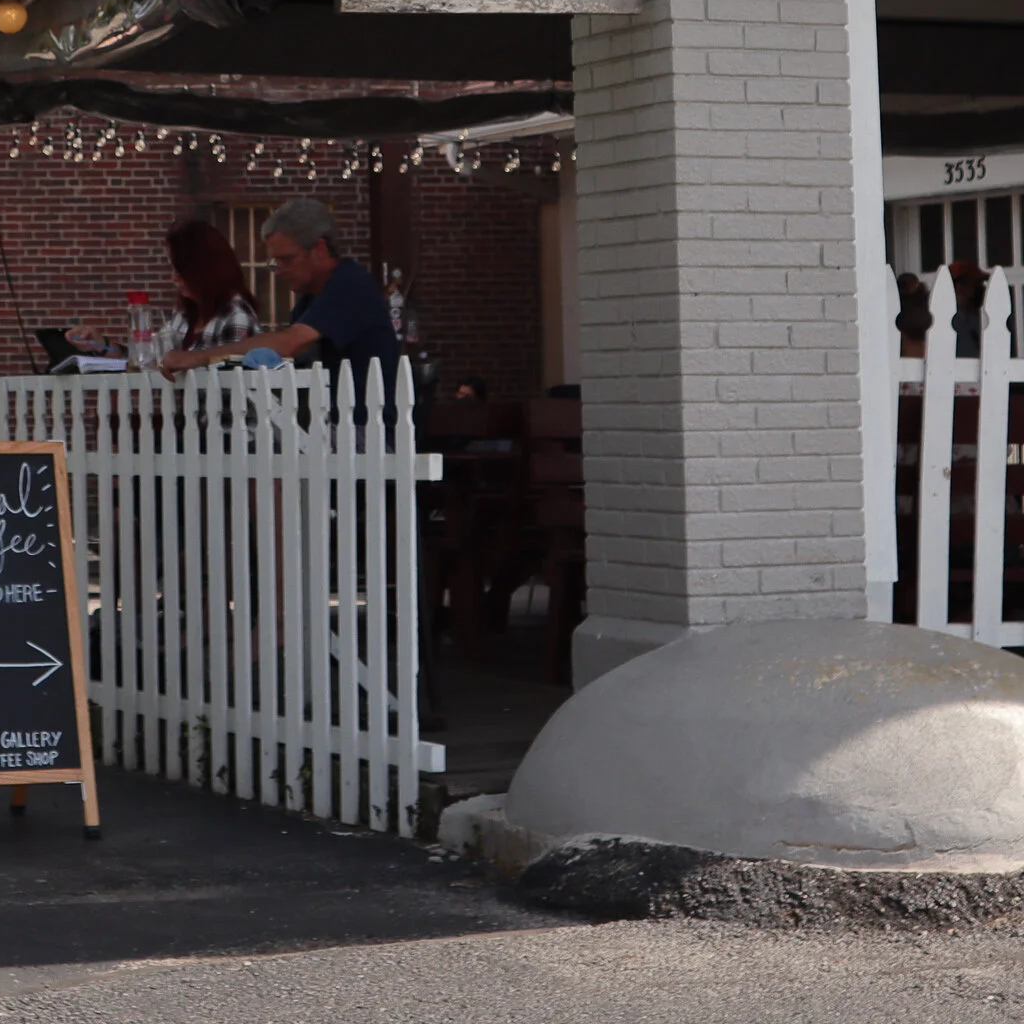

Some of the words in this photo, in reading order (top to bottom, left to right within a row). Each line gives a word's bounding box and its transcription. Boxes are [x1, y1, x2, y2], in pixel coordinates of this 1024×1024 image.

[943, 156, 987, 185] 3535
[5, 583, 43, 603] HERE
[0, 731, 63, 749] GALLERY
[25, 750, 59, 767] SHOP
